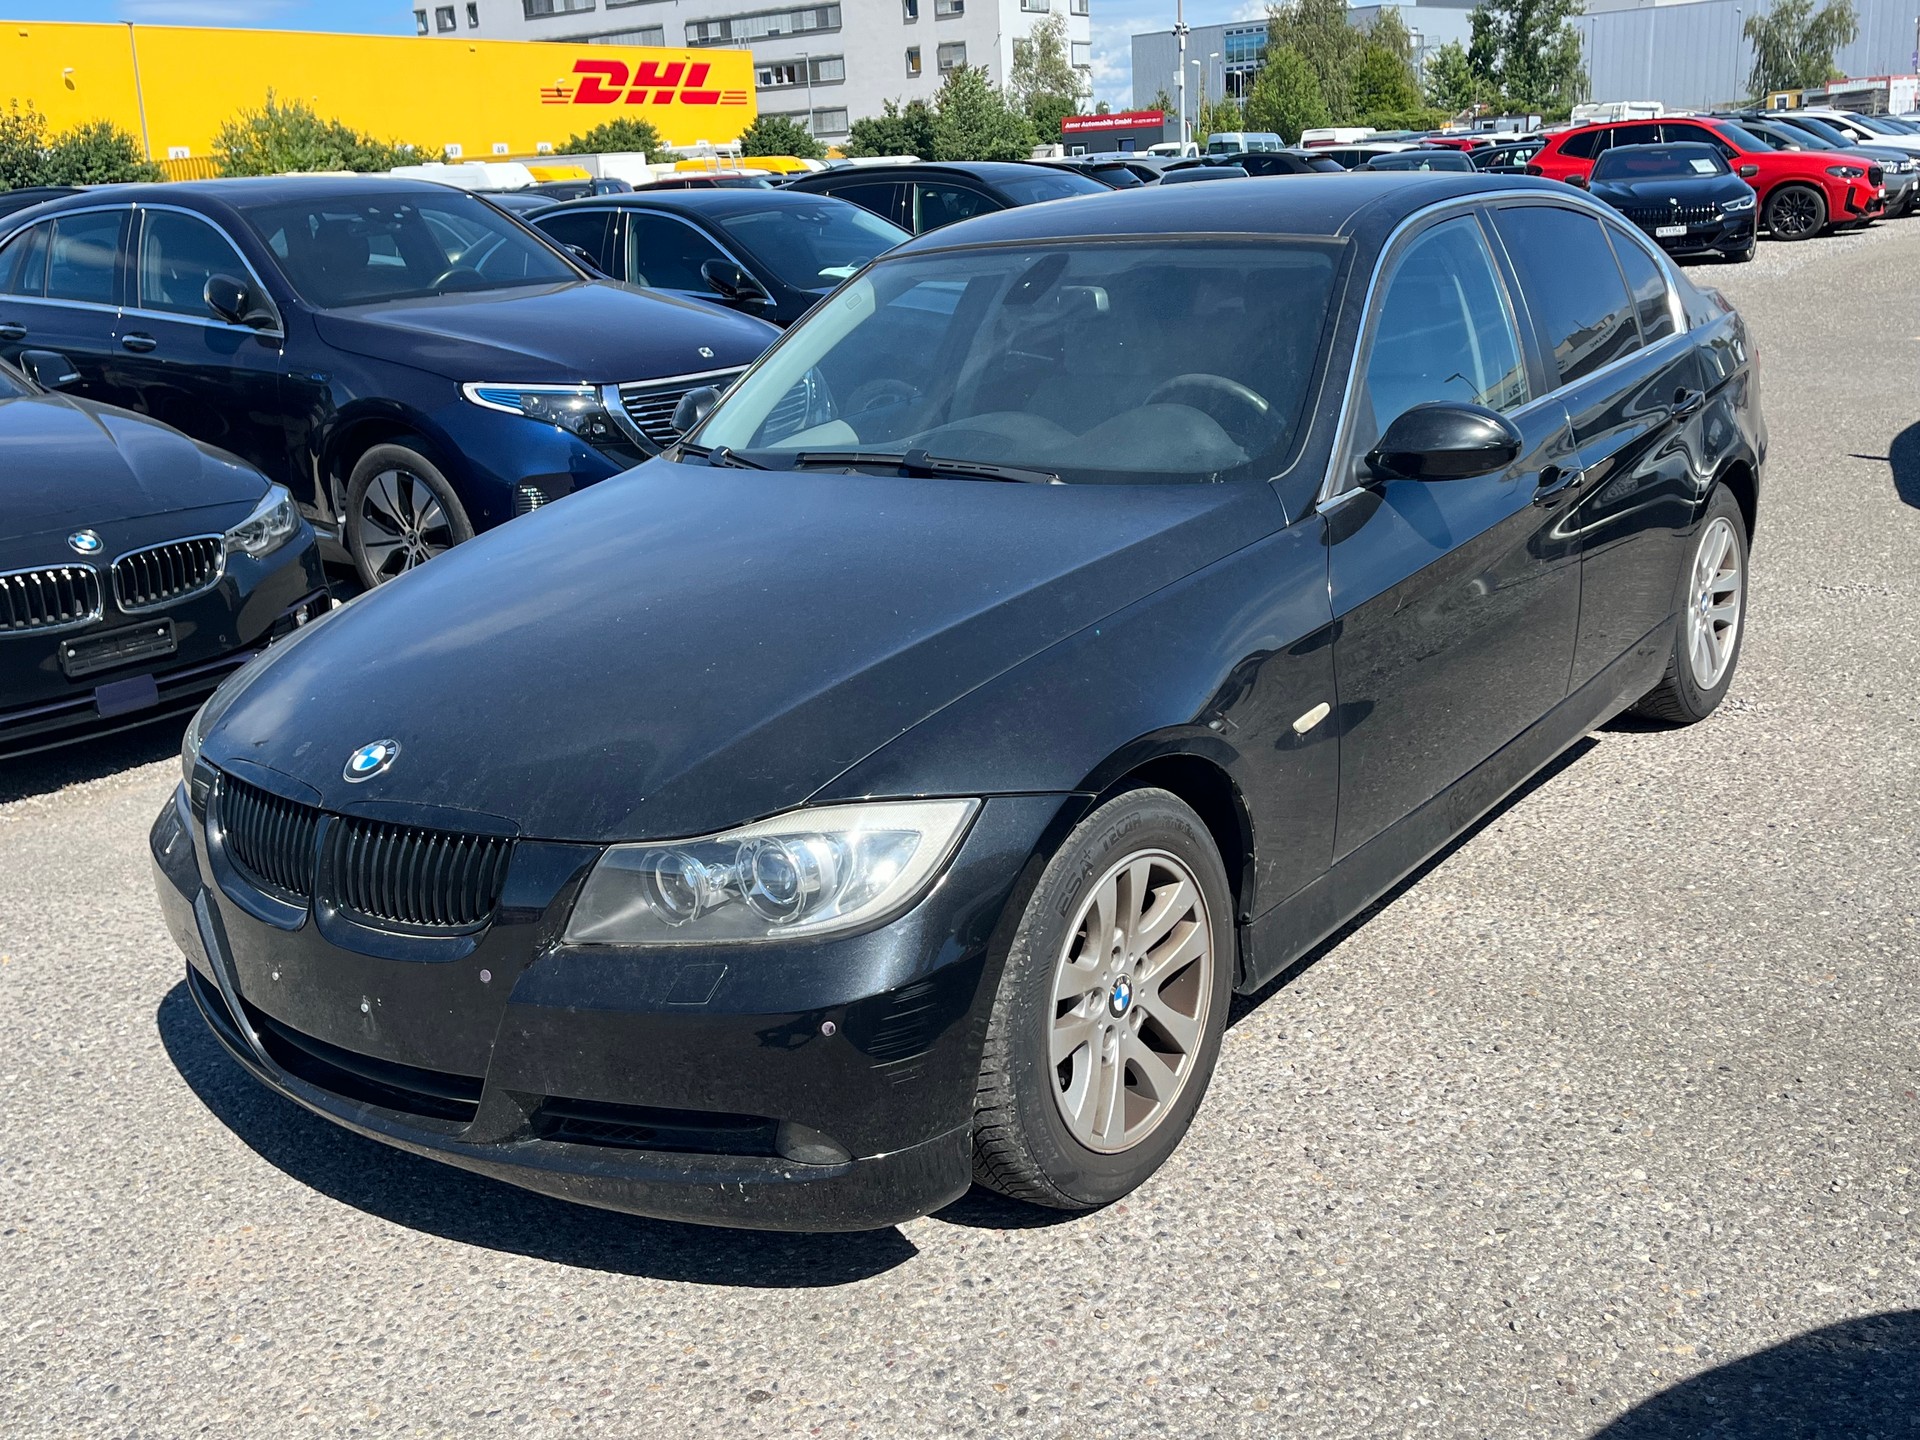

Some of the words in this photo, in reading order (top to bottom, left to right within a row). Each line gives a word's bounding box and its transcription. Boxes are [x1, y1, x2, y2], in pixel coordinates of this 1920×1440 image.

[572, 60, 721, 104] DHL
[1065, 121, 1081, 129] Amer
[1081, 119, 1113, 128] Automobile
